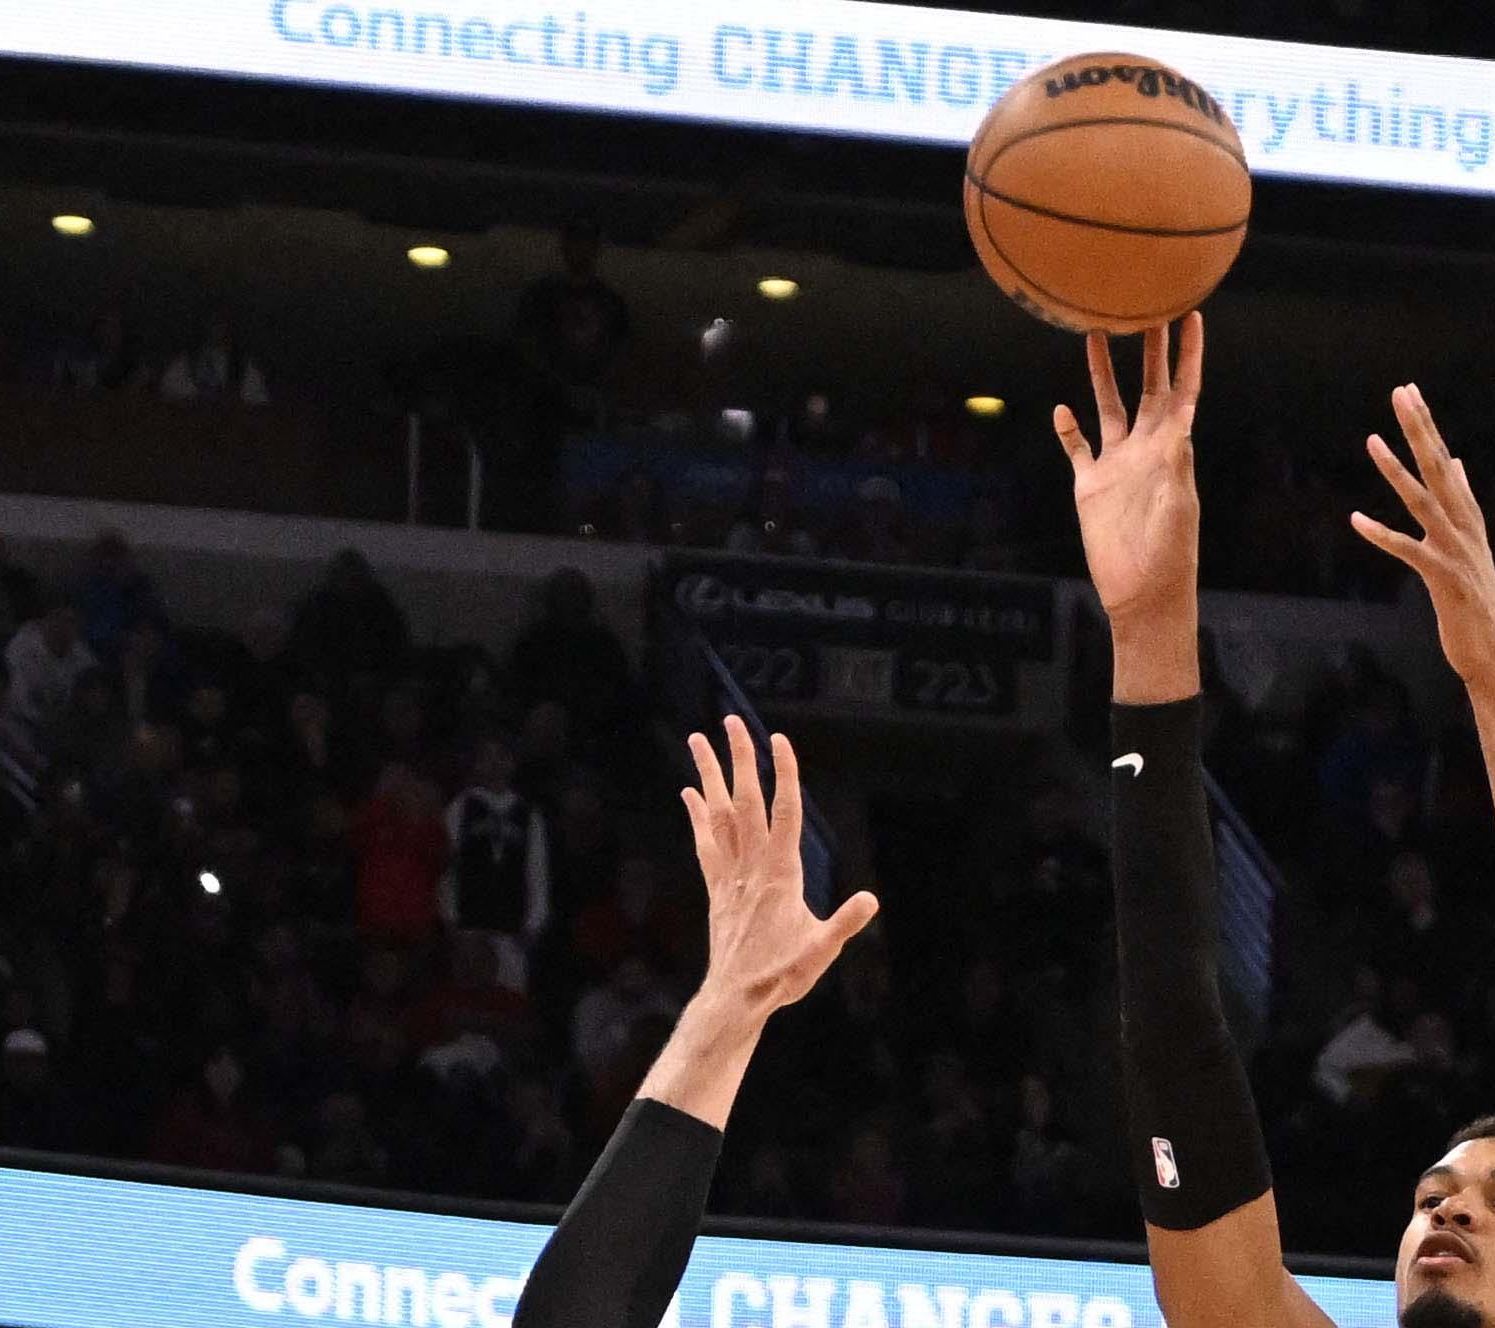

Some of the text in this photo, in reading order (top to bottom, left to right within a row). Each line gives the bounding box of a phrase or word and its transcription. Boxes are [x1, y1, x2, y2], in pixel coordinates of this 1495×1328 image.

[271, 0, 1492, 171] Connecting CHANGE rything
